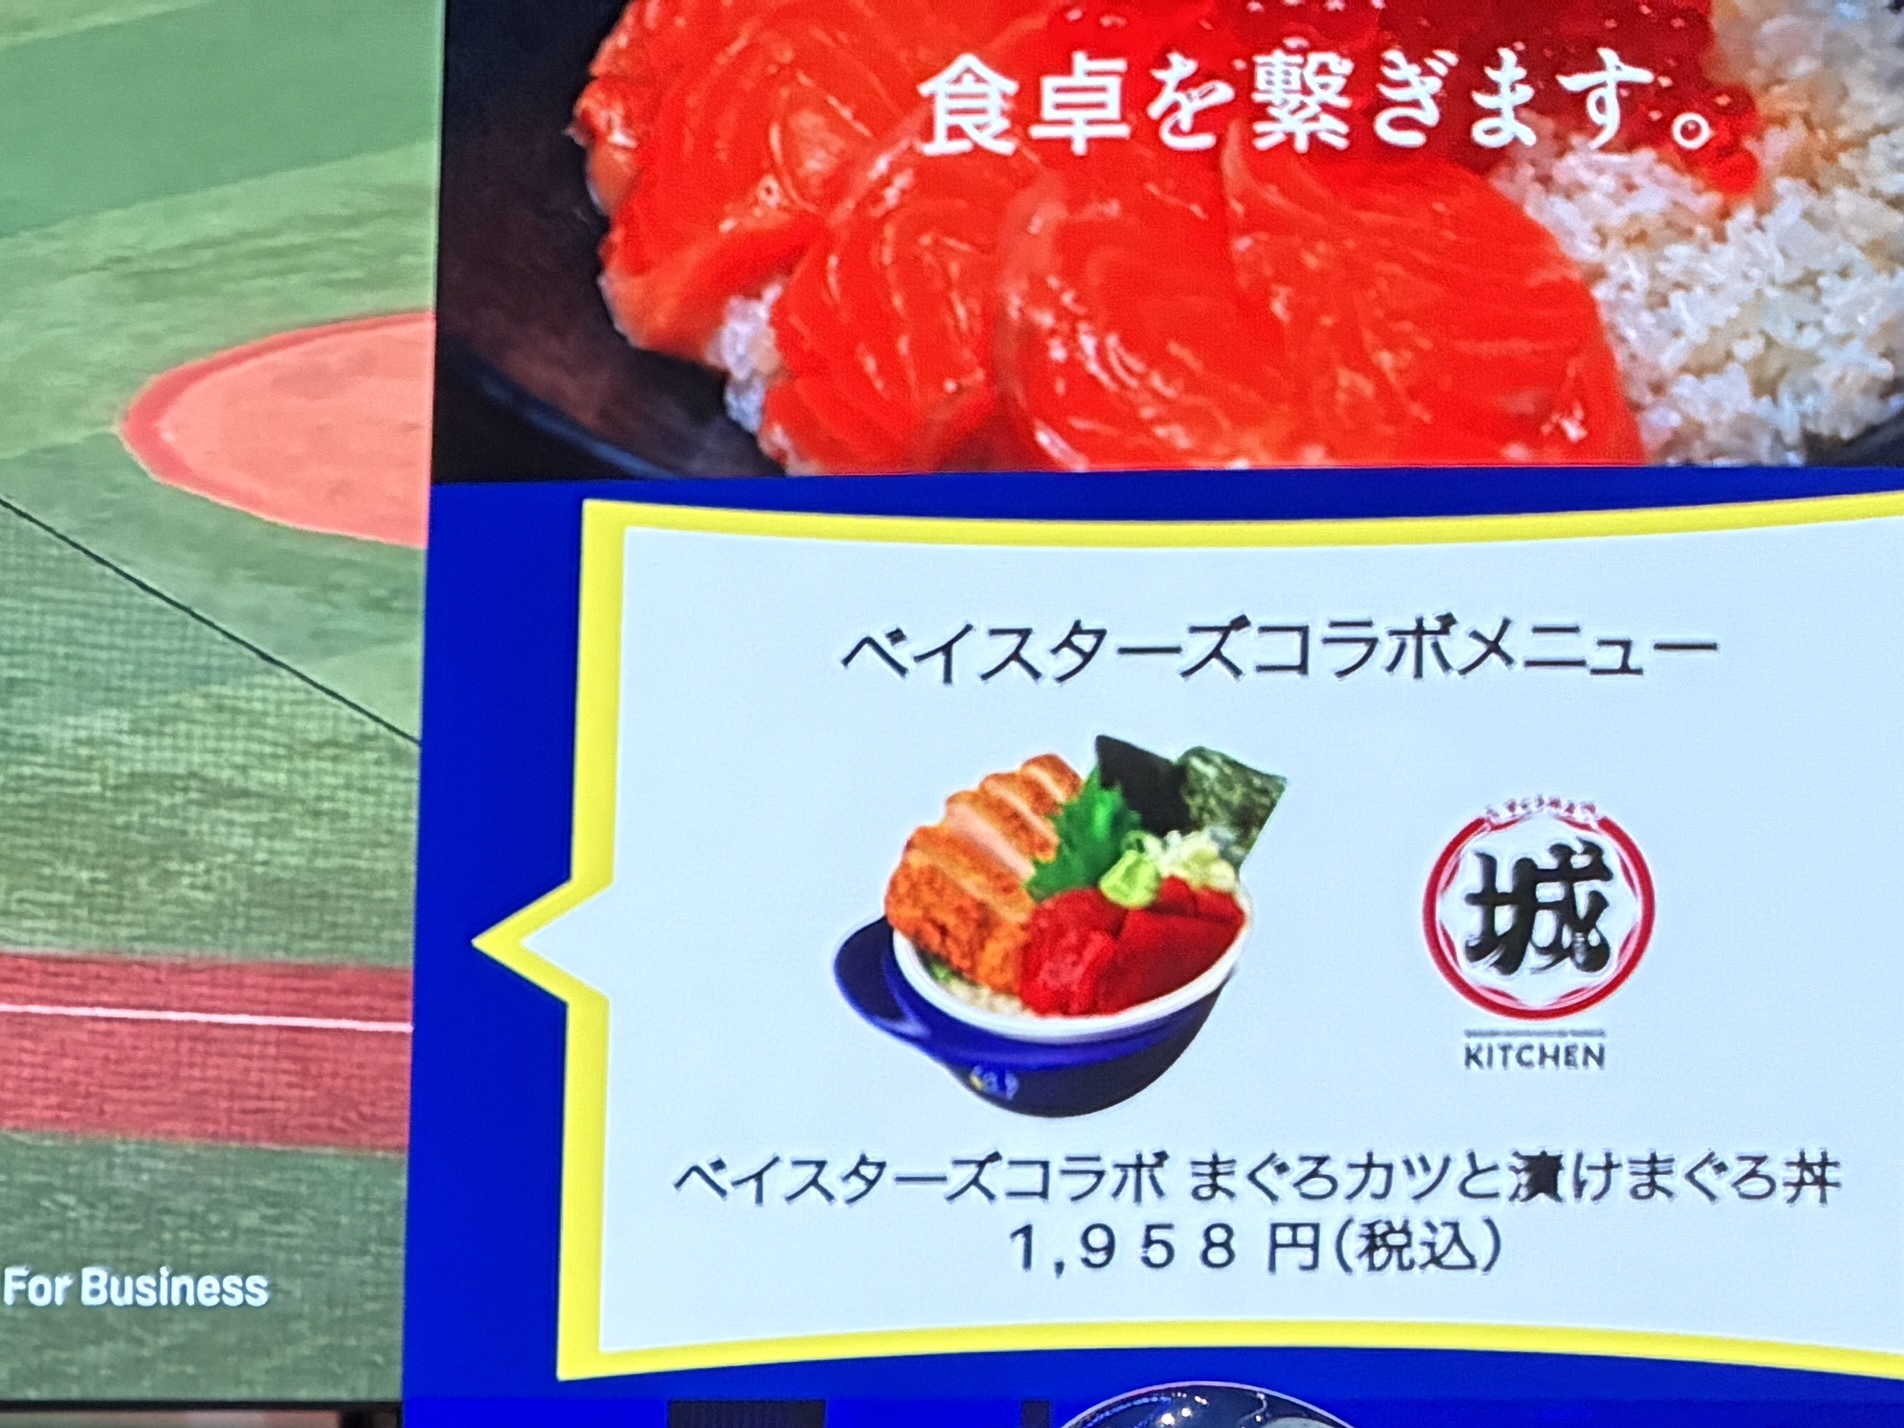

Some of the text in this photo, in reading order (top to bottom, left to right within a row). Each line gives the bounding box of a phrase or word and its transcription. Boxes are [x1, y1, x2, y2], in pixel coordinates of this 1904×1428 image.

[916, 51, 1713, 158] 食卓を繋ぎます。
[840, 614, 1719, 686] ベイスターズコラボメニュー
[1462, 842, 1616, 977] 城
[1462, 1042, 1607, 1072] KITCHEN
[674, 1151, 1168, 1208] ベイスターズコラボ
[4, 1266, 270, 1308] For Business
